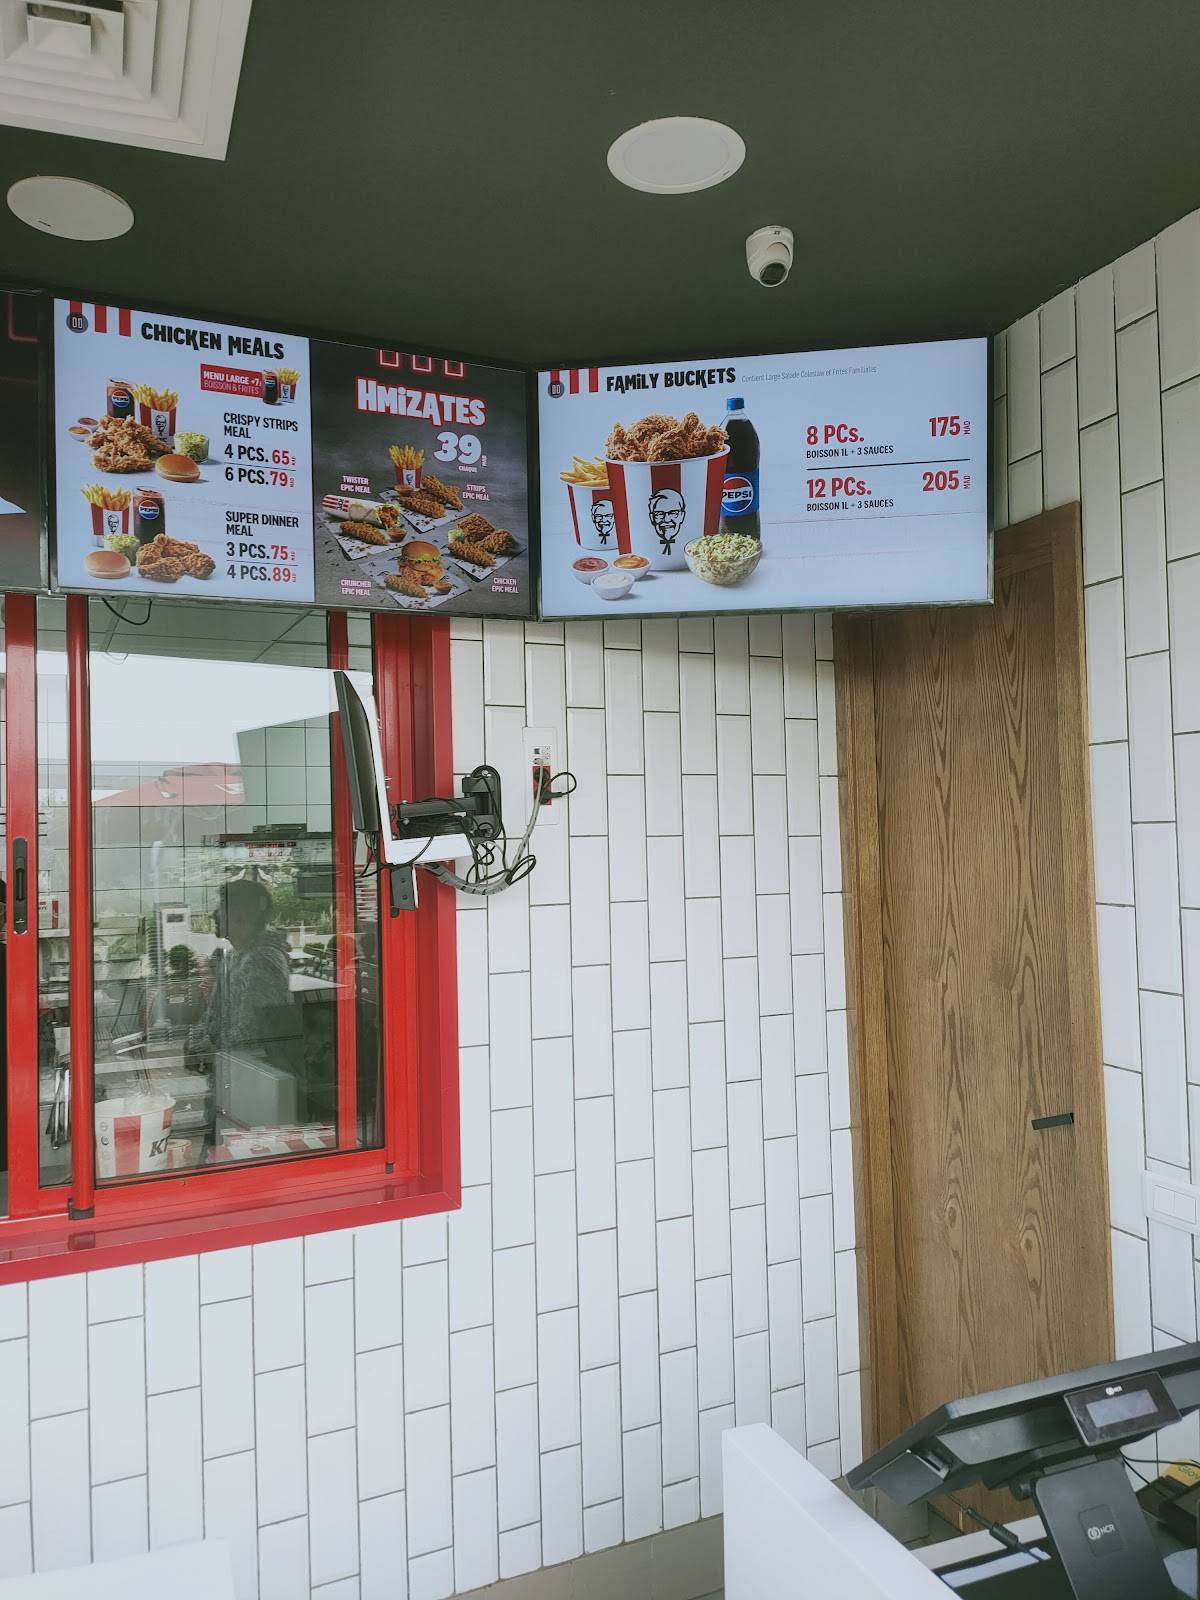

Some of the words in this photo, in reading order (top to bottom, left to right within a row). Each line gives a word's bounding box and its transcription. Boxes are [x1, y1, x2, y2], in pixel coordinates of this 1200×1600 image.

[141, 322, 222, 351] CHICKEN
[228, 335, 285, 360] MEALS
[203, 370, 225, 382] MENU
[225, 373, 250, 385] LARGE
[664, 367, 736, 389] BUCKETS
[204, 380, 232, 391] BOISSON
[238, 384, 260, 395] FRITES
[223, 412, 261, 427] CRISPY
[262, 417, 299, 432] STRIPS
[963, 420, 971, 435] MAD
[223, 425, 252, 439] MEAL
[806, 425, 819, 446] 8
[928, 415, 961, 437] 175
[224, 443, 234, 459] 4
[237, 445, 269, 463] PCS.
[271, 449, 290, 466] 65
[433, 431, 482, 465] 39
[806, 448, 840, 459] BOISSON
[840, 447, 849, 457] 1L
[857, 447, 862, 456] 3
[863, 445, 894, 455] SAUCES
[225, 466, 234, 482] 6
[238, 467, 269, 485] PCS.
[270, 470, 288, 487] 79
[342, 475, 369, 485] TWISTER
[806, 478, 826, 499] 12
[921, 469, 960, 492] 205
[963, 475, 971, 490] MAD
[340, 484, 354, 492] EPIC
[354, 485, 372, 494] MEAL
[466, 484, 486, 492] STRIPS
[721, 490, 752, 499] PEPSI
[462, 491, 475, 500] EPIC
[475, 493, 490, 501] MEAL
[806, 501, 840, 512] BOISSON
[841, 500, 849, 510] 1L
[857, 500, 862, 509] 3
[863, 498, 894, 509] SAUCES
[225, 510, 259, 525] SUPER
[261, 514, 299, 528] DINNER
[226, 523, 254, 537] MEAL
[226, 541, 235, 557] 3
[239, 542, 270, 560] PCS.
[271, 544, 288, 561] 75
[227, 564, 236, 579] 4
[240, 565, 271, 582] PCS.
[272, 566, 291, 583] 89
[340, 579, 372, 588] CRUNCHER
[493, 577, 517, 586] CHICKEN
[341, 587, 355, 595] EPIC
[355, 588, 371, 596] MEAL
[491, 585, 504, 593] EPIC
[504, 586, 520, 594] MEAL
